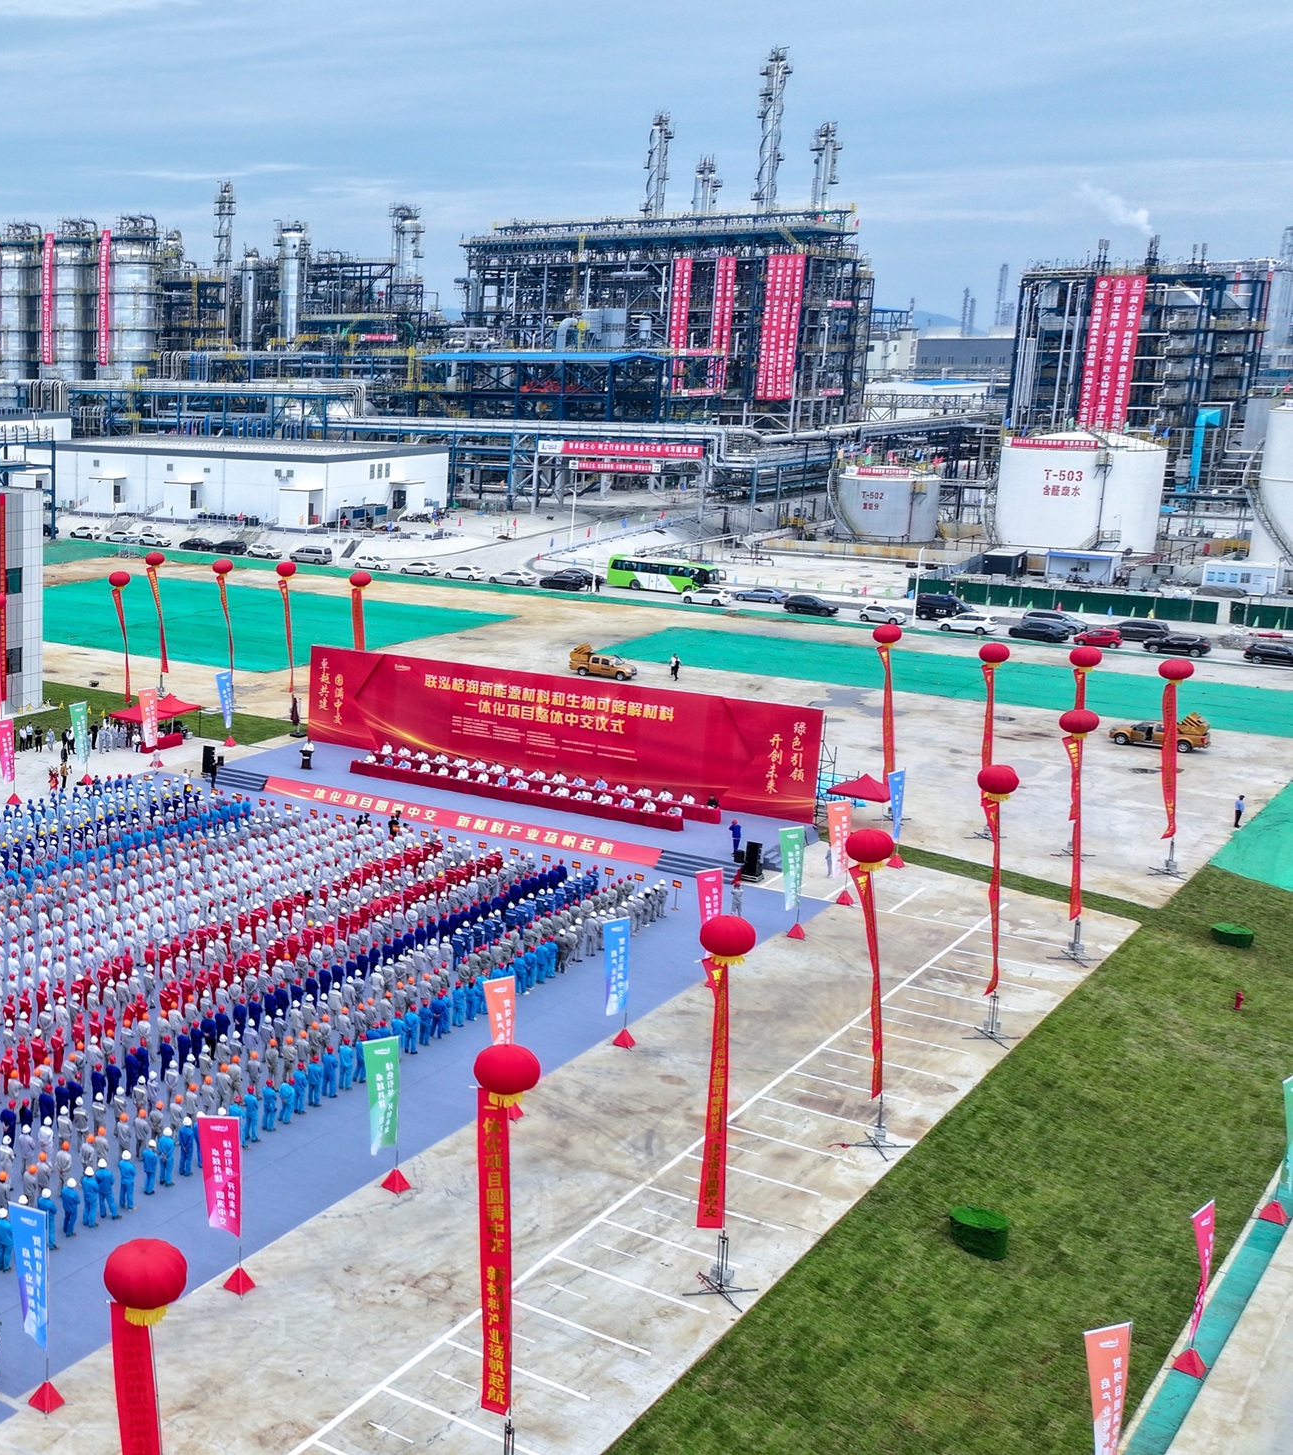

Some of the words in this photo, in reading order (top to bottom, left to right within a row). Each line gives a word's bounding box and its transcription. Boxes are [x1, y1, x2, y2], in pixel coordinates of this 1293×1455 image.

[1109, 296, 1123, 328] 精工细作
[1125, 296, 1139, 328] 凝心聚力
[1104, 330, 1117, 362] 品质为先
[1119, 330, 1133, 362] 跨越发展
[861, 491, 884, 500] T-502
[1044, 469, 1084, 482] T-503
[318, 657, 331, 711] 卓越共建
[333, 673, 344, 726] 圆满中交
[423, 673, 675, 722] 联泓格润新能源材料和生物可降解材料
[464, 700, 625, 734] 一体化项目整体中交仪式
[765, 733, 784, 795] 开创未来
[789, 721, 807, 783] 绿色引领
[299, 787, 437, 822] 一体化项目圆满中交
[456, 815, 614, 855] 新材料产业扬帆起航
[483, 1104, 505, 1253] 一体化项目圆满中交
[486, 1265, 506, 1406] 新材料产业扬帆起航
